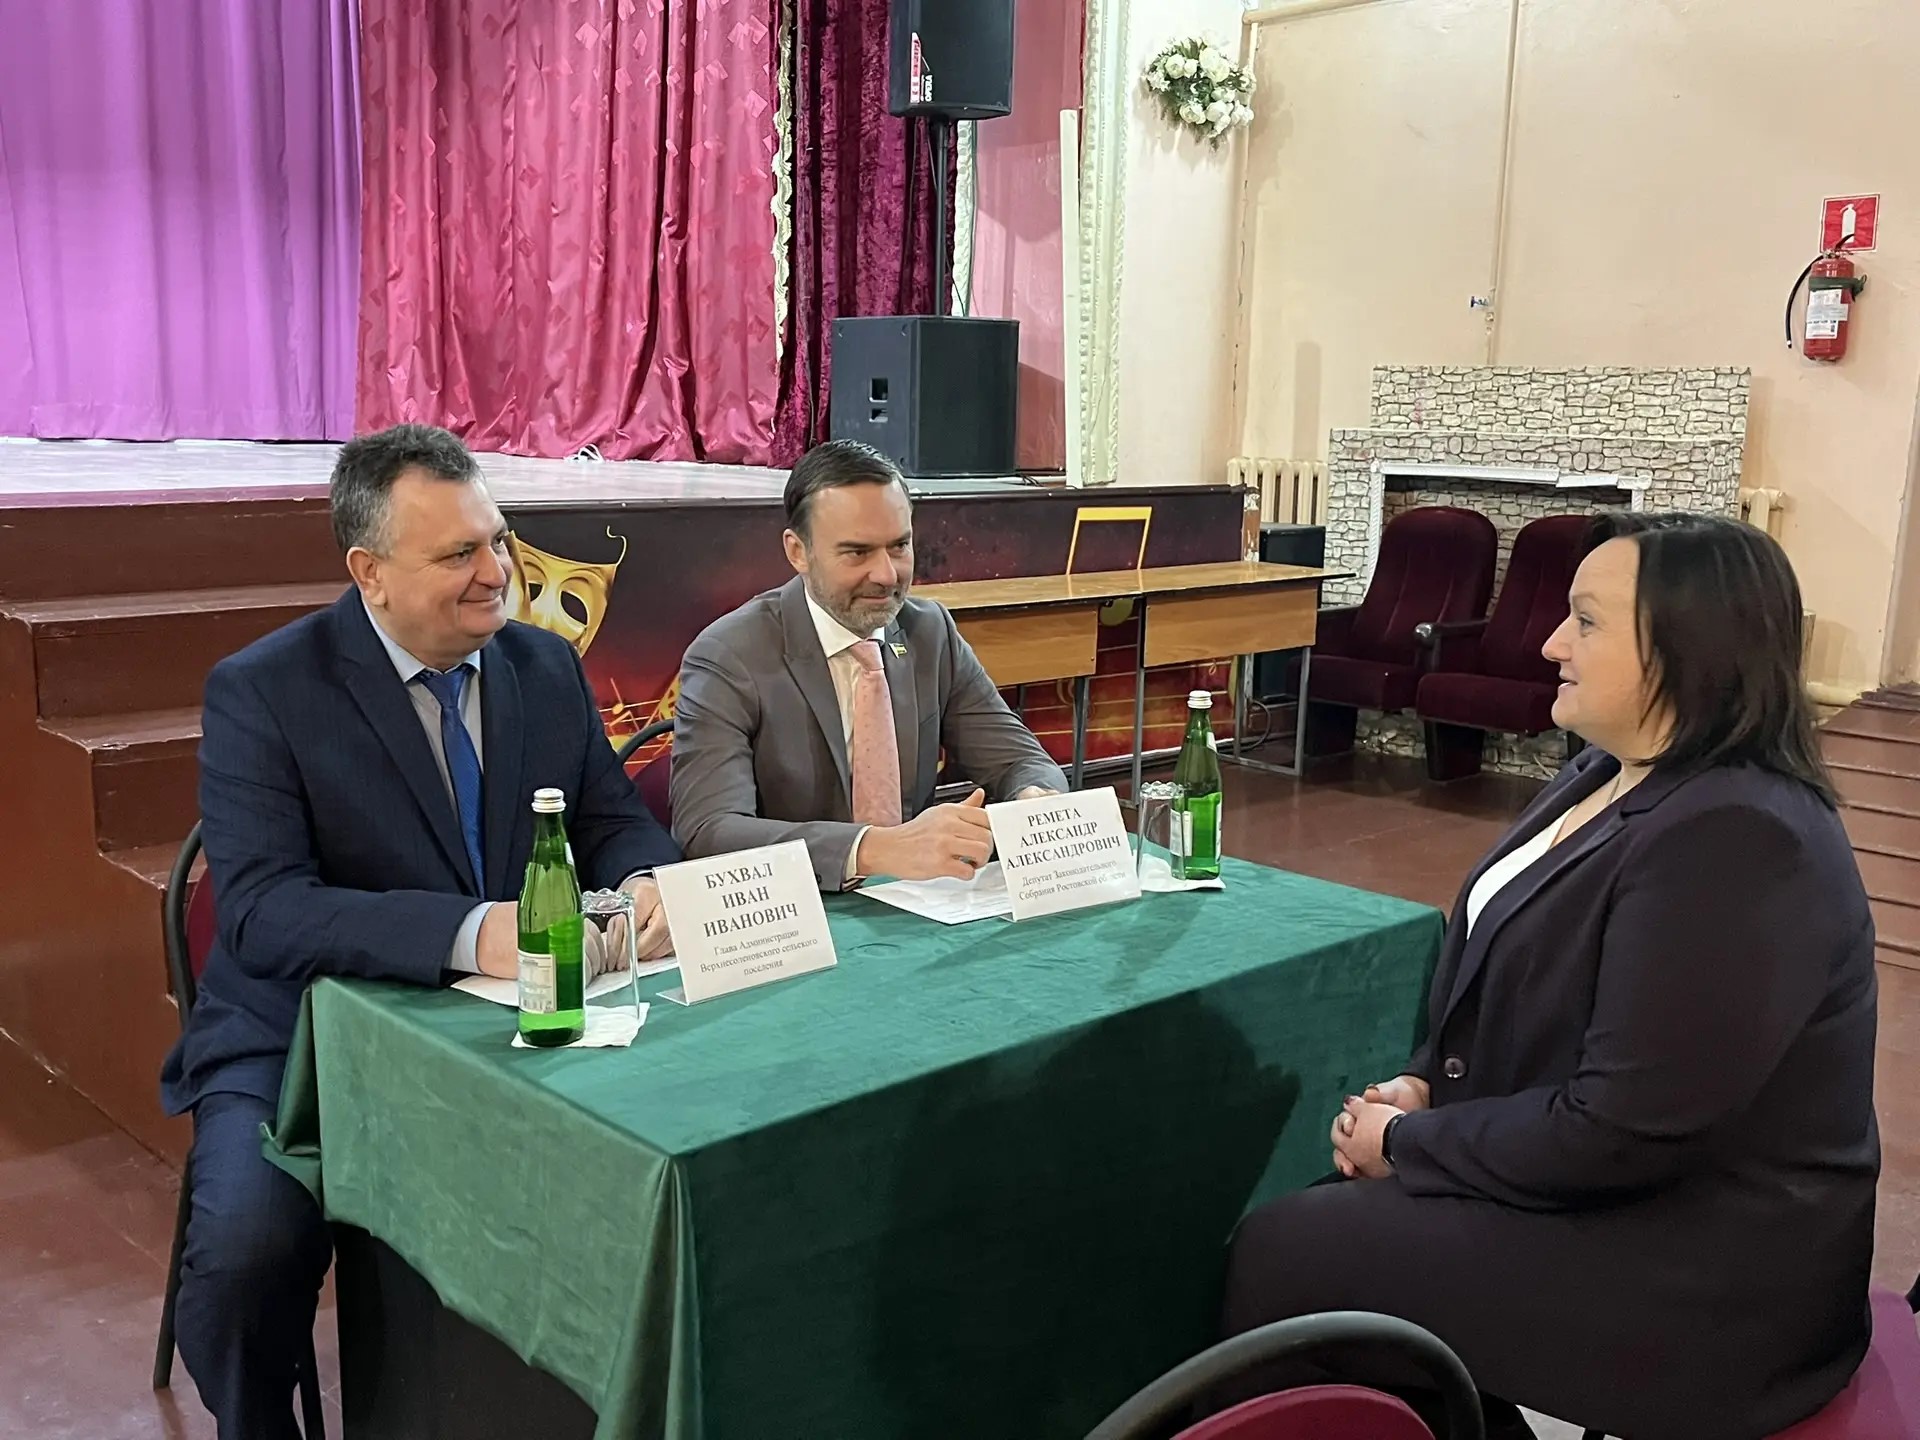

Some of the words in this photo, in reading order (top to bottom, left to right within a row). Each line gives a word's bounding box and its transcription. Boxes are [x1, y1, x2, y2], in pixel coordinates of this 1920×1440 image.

[1027, 807, 1082, 827] РЕМЕТА
[1019, 821, 1099, 848] АЛЕКСАНДР
[1005, 835, 1122, 870] АЛЕКСАНДРОВИЧ
[704, 863, 774, 889] БУХВАЛ
[1018, 886, 1055, 900] Собрания
[1056, 876, 1098, 892] Ростовской
[1098, 871, 1126, 884] обсти
[1022, 873, 1052, 888] Депутат
[721, 886, 770, 909] ИВАН
[703, 903, 799, 937] ИВАНОВИЧ
[713, 944, 738, 956] Глава
[739, 930, 799, 950] Администрации
[781, 938, 818, 953] сельского
[743, 959, 784, 976] поселения
